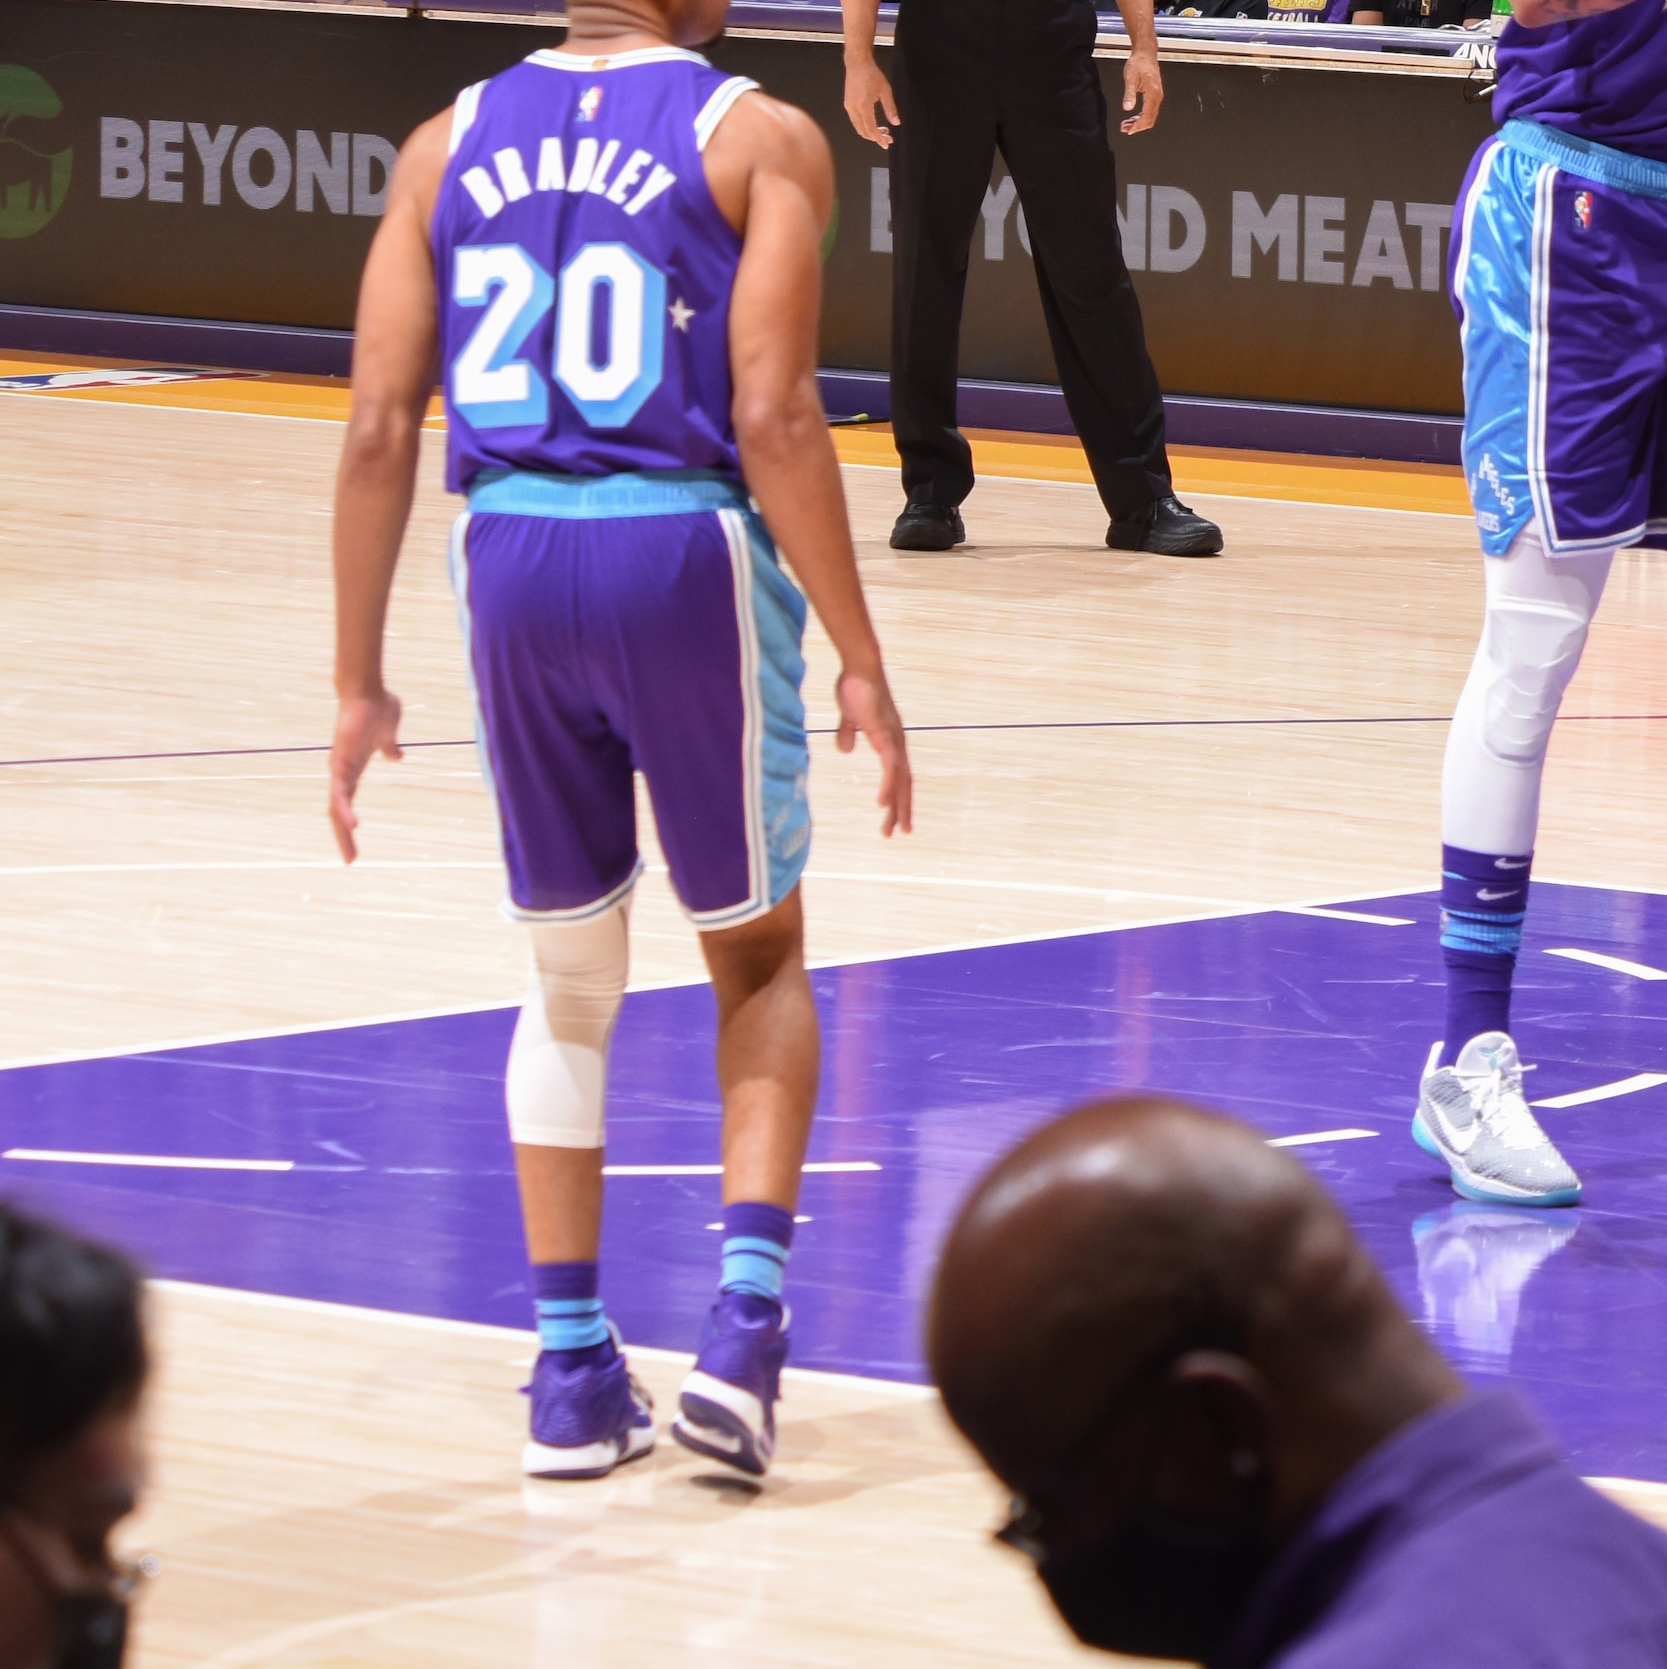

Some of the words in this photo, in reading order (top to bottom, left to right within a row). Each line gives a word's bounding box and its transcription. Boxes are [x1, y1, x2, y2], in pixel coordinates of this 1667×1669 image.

[101, 117, 398, 216] BEYOND
[462, 137, 679, 219] BRADLEY
[1231, 190, 1453, 292] MEAT
[454, 241, 668, 429] 20
